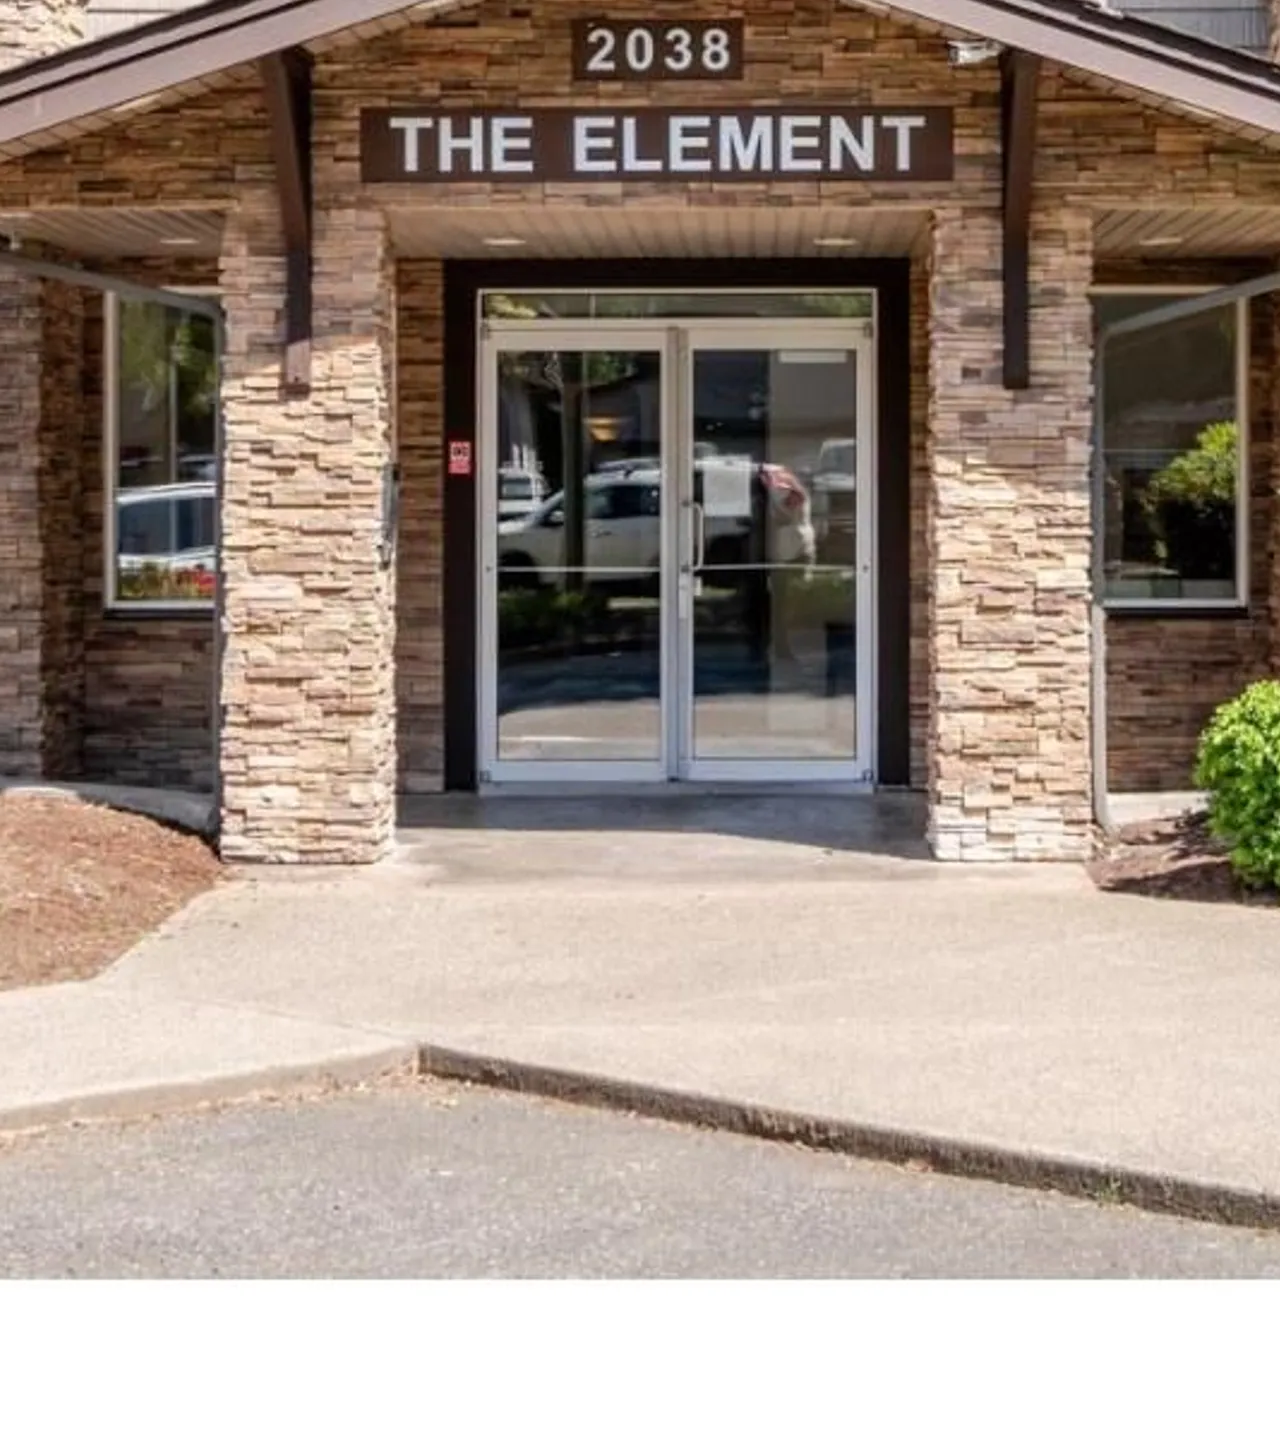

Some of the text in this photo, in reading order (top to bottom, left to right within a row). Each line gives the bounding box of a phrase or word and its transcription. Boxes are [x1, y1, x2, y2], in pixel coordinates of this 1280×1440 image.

[587, 29, 730, 71] 2038
[390, 116, 926, 172] THE ELEMENT
